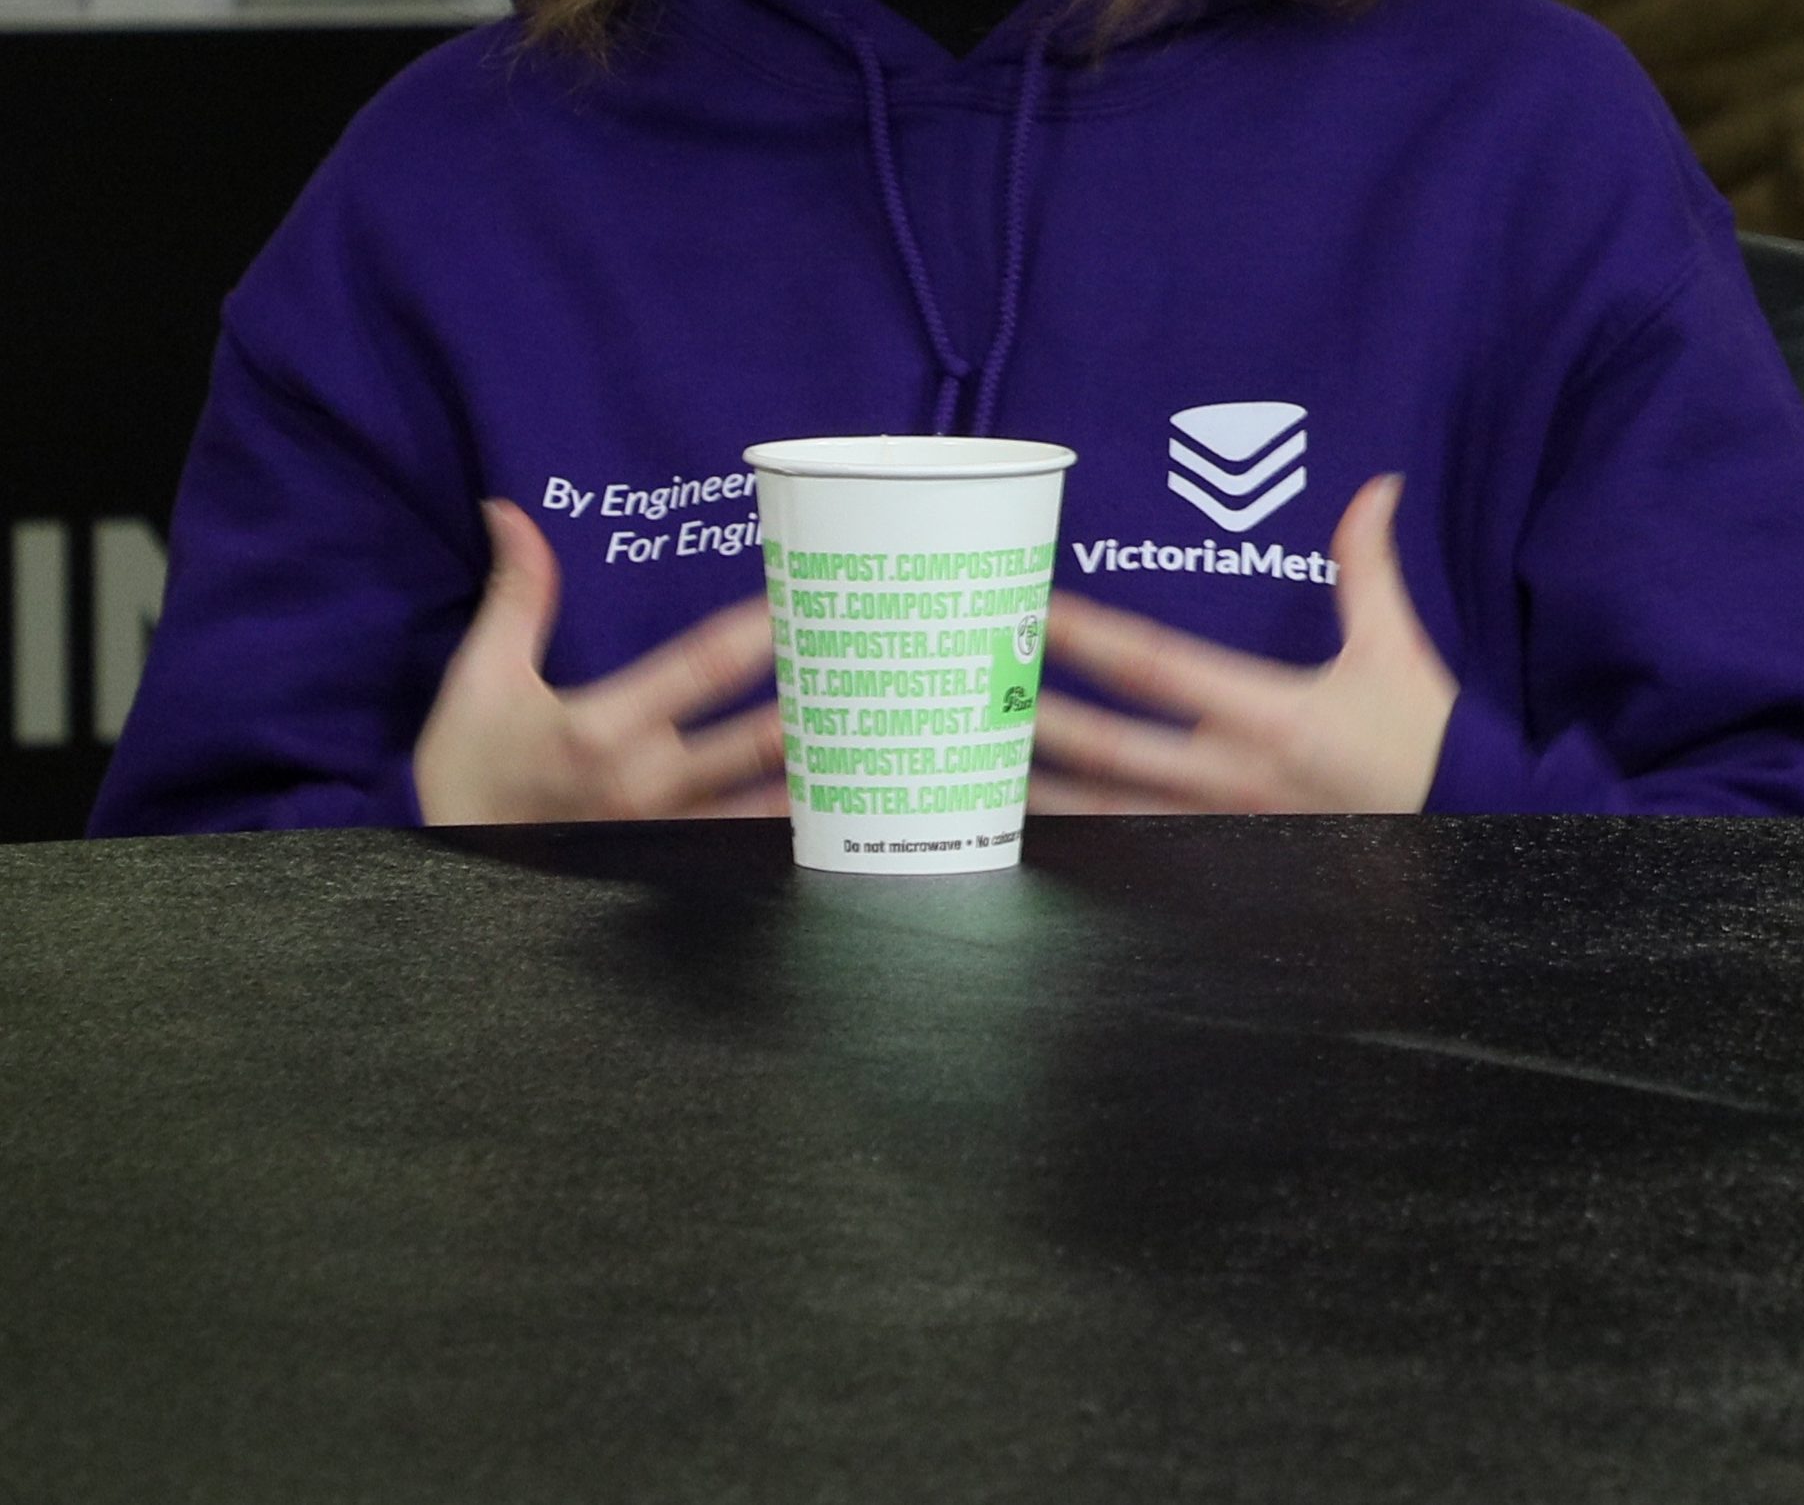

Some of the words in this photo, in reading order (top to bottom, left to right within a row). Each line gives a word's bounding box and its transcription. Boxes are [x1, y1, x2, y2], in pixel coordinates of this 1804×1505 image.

[542, 475, 596, 519] By
[605, 530, 671, 565] For
[675, 511, 763, 557] Engi
[844, 838, 860, 854] Do
[863, 839, 885, 854] not
[889, 837, 962, 854] microwave
[975, 834, 990, 849] No
